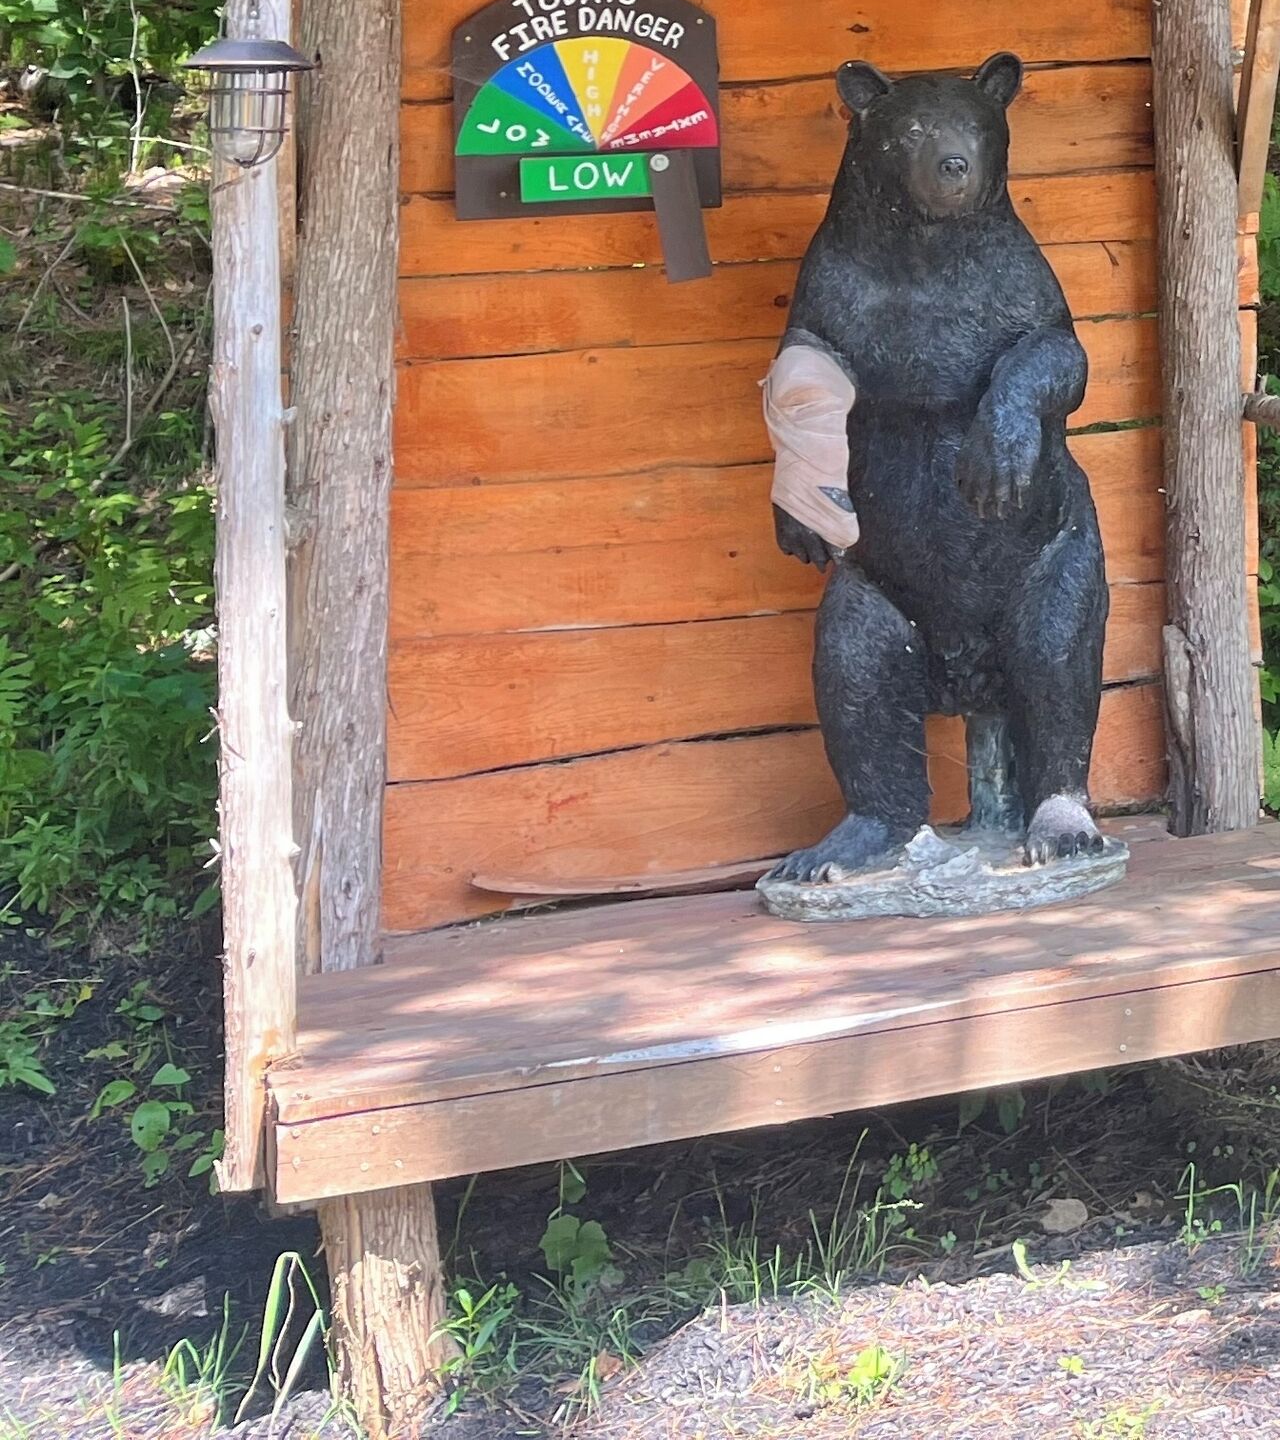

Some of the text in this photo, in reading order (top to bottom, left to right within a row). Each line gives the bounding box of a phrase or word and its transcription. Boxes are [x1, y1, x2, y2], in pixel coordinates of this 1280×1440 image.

[491, 7, 685, 61] FIRE DANGER
[516, 62, 595, 144] MODERATE
[582, 49, 601, 117] HIGH
[624, 57, 666, 106] VERY
[476, 118, 551, 148] LOW
[610, 110, 709, 149] EXTREME
[548, 161, 634, 192] LOW
